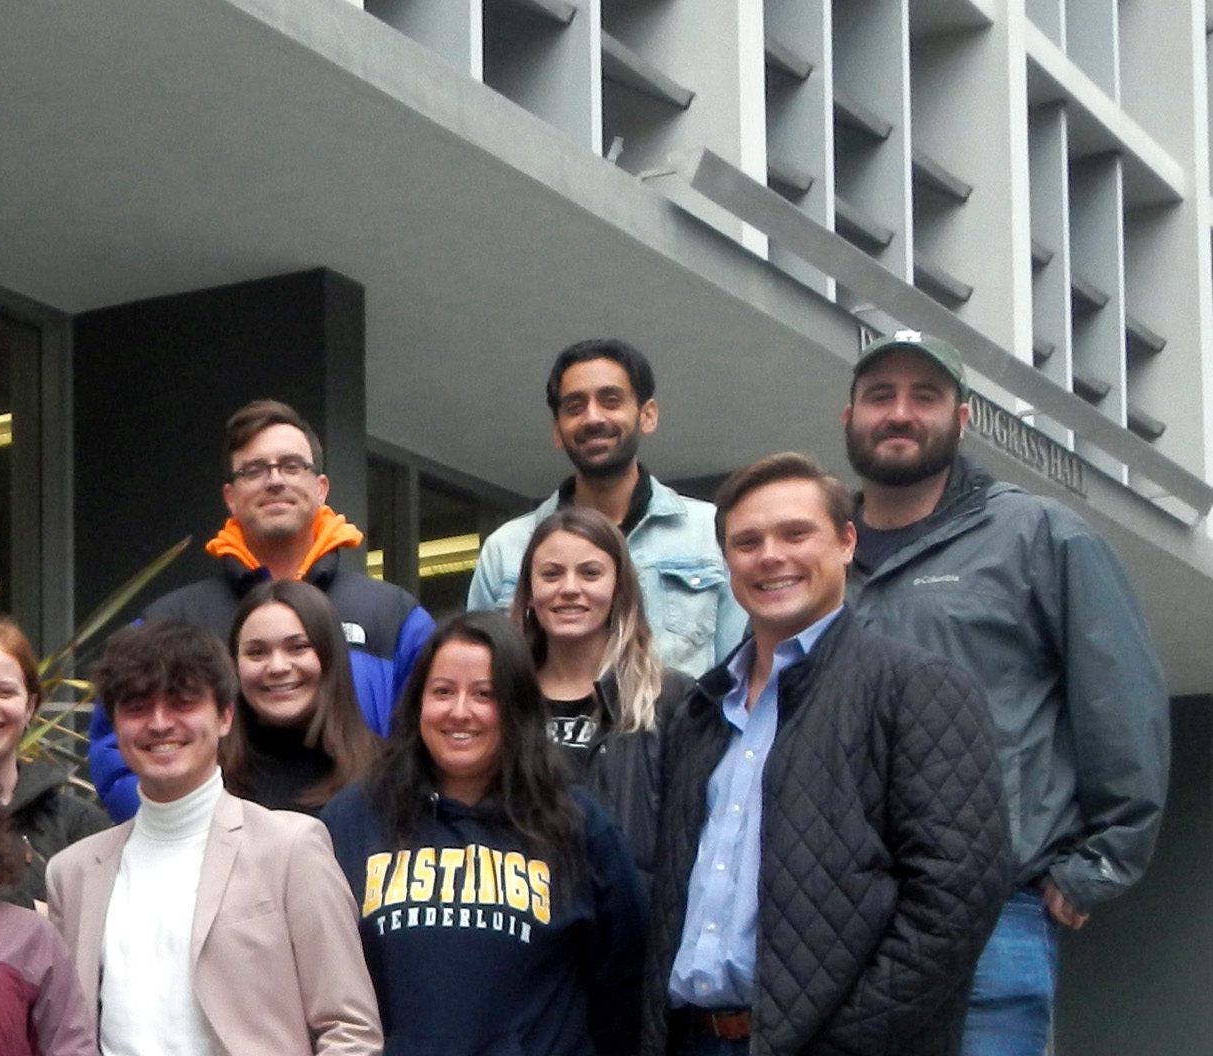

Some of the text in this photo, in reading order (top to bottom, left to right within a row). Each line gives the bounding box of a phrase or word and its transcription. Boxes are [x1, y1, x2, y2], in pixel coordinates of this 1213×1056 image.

[967, 394, 1049, 472] ODGRASS
[362, 844, 551, 925] HASTINGS
[377, 907, 532, 943] TENDERLOIN
